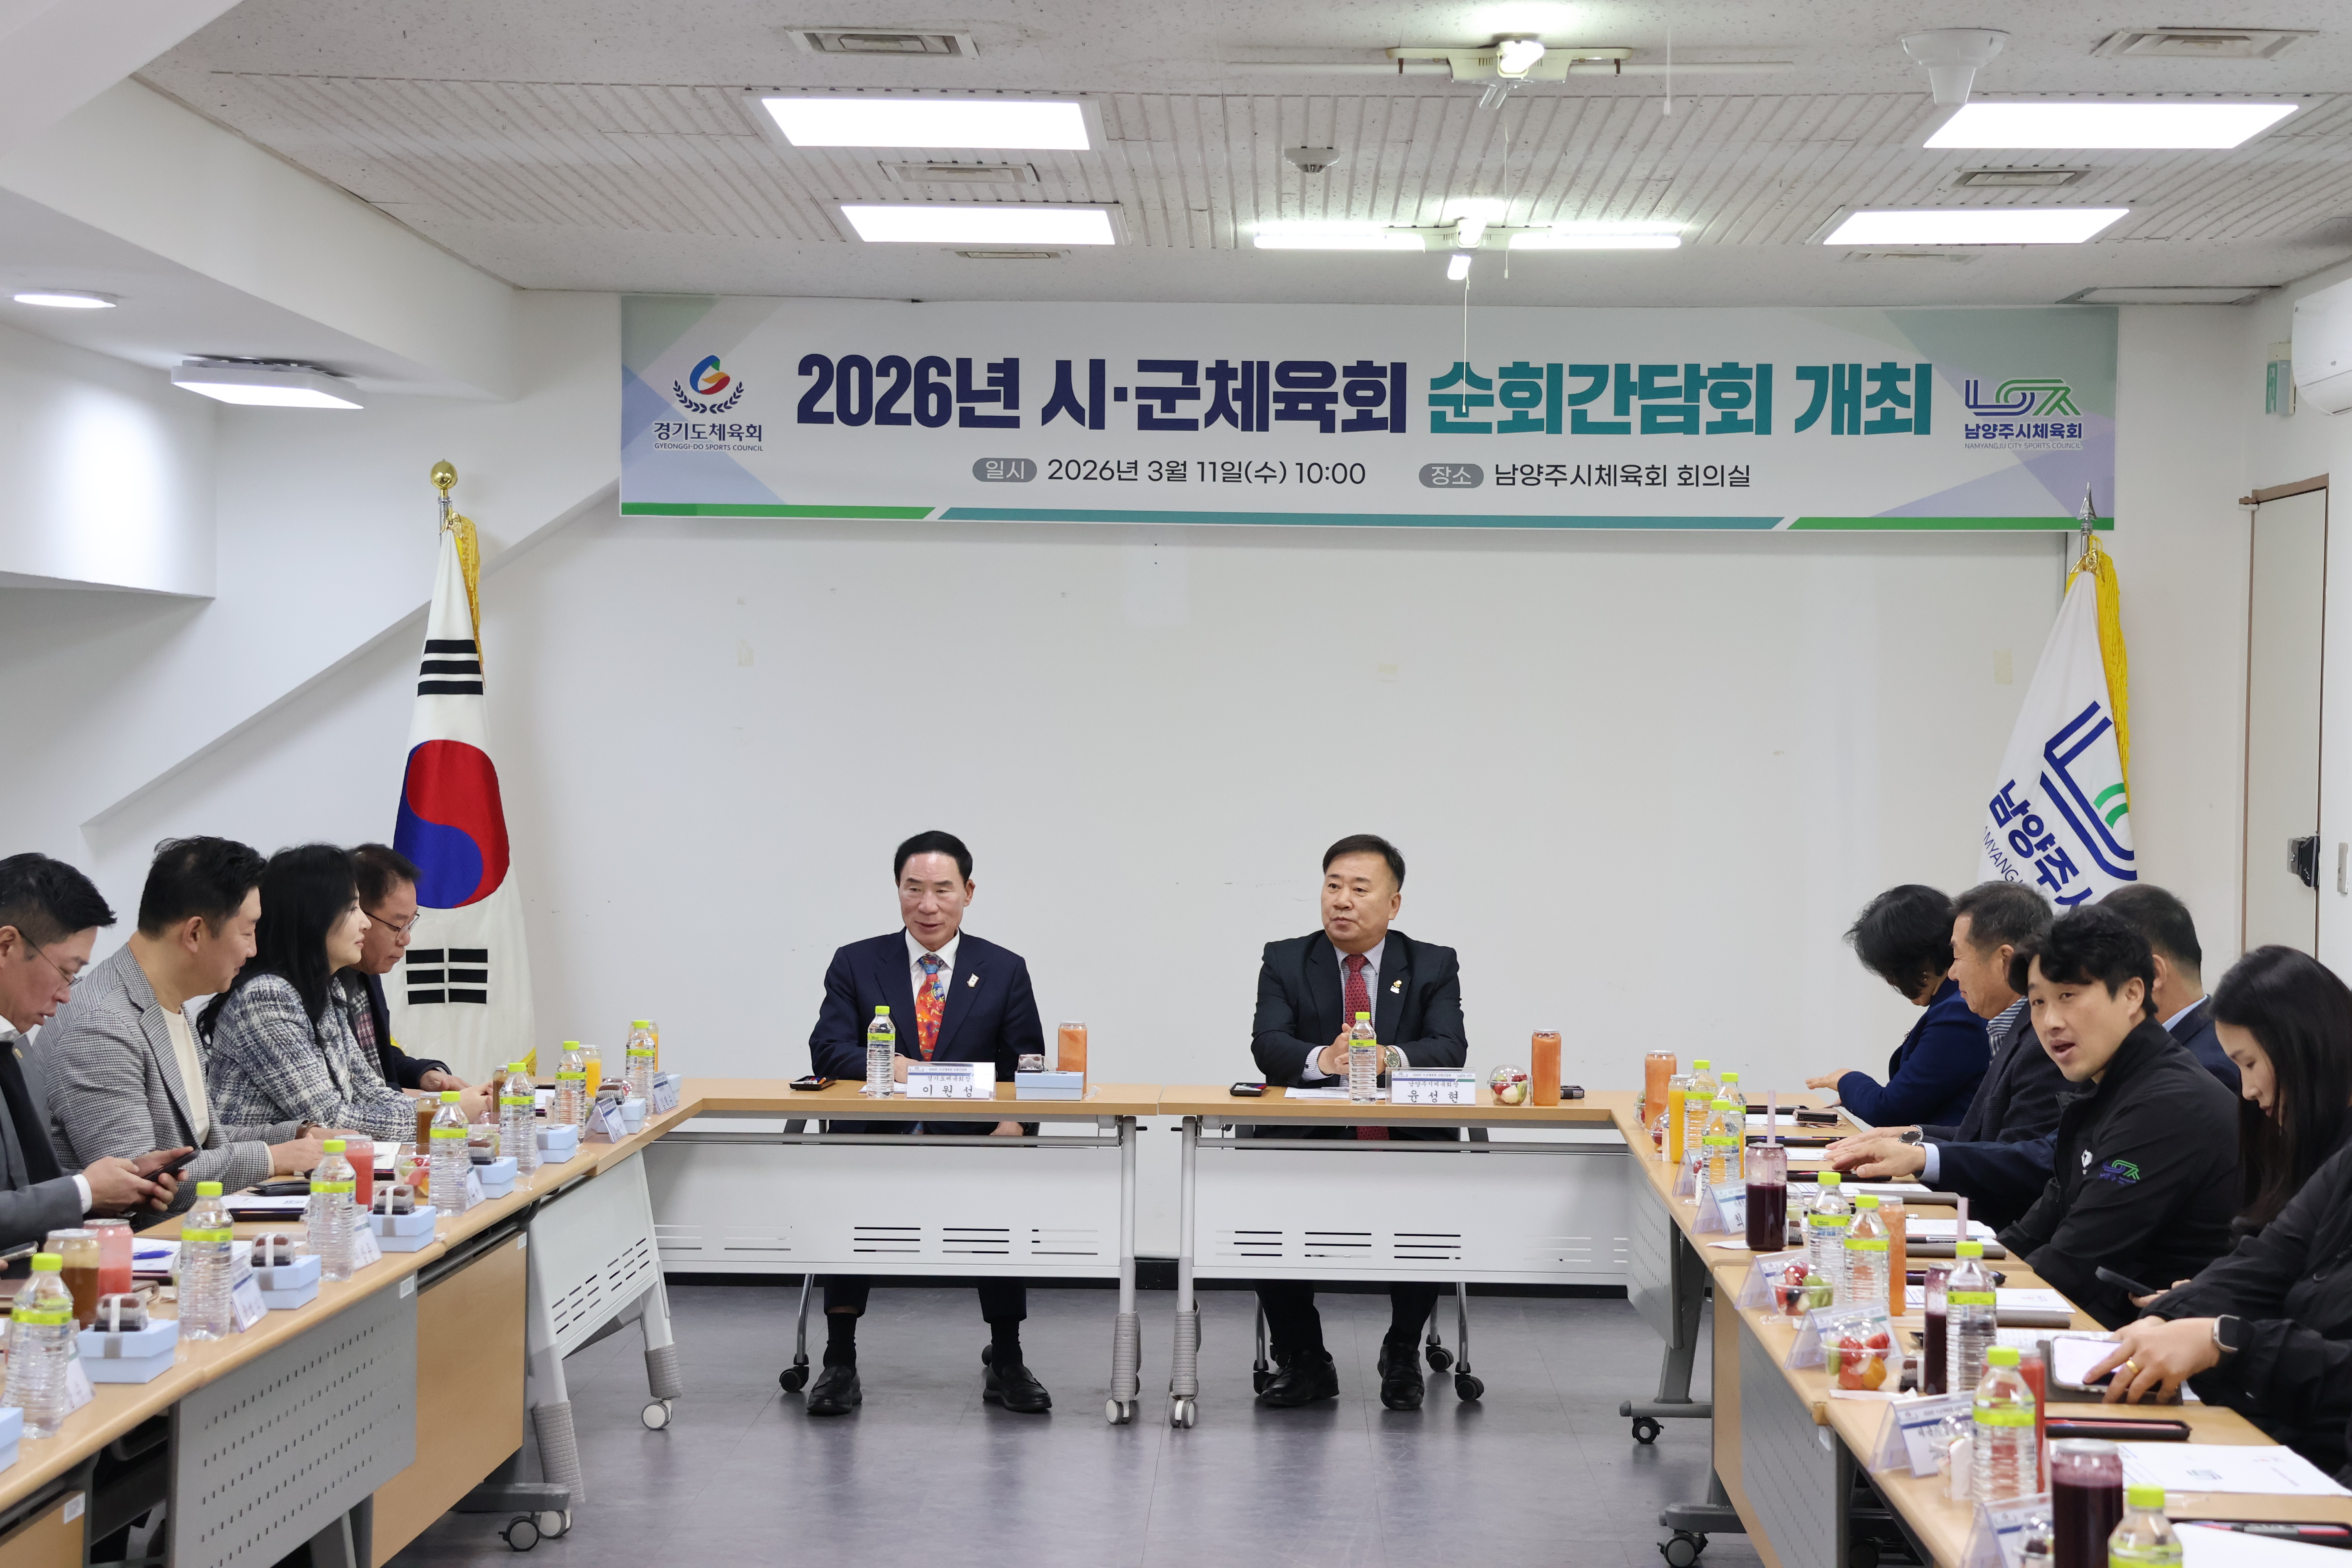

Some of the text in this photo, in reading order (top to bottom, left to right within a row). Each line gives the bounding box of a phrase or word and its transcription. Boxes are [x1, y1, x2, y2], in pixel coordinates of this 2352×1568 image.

[797, 354, 1932, 435] 2026년 시·군체육회 순회간담회 개최
[653, 423, 762, 442] 경기도체육회
[1965, 423, 2082, 439] 남양주시체육회
[986, 461, 1025, 480] 일시
[1048, 459, 1366, 485] 2026년 3월 11일(수) 10:00
[1431, 466, 1472, 485] 장소
[1495, 464, 1750, 488] 남양주시체육회 회의실
